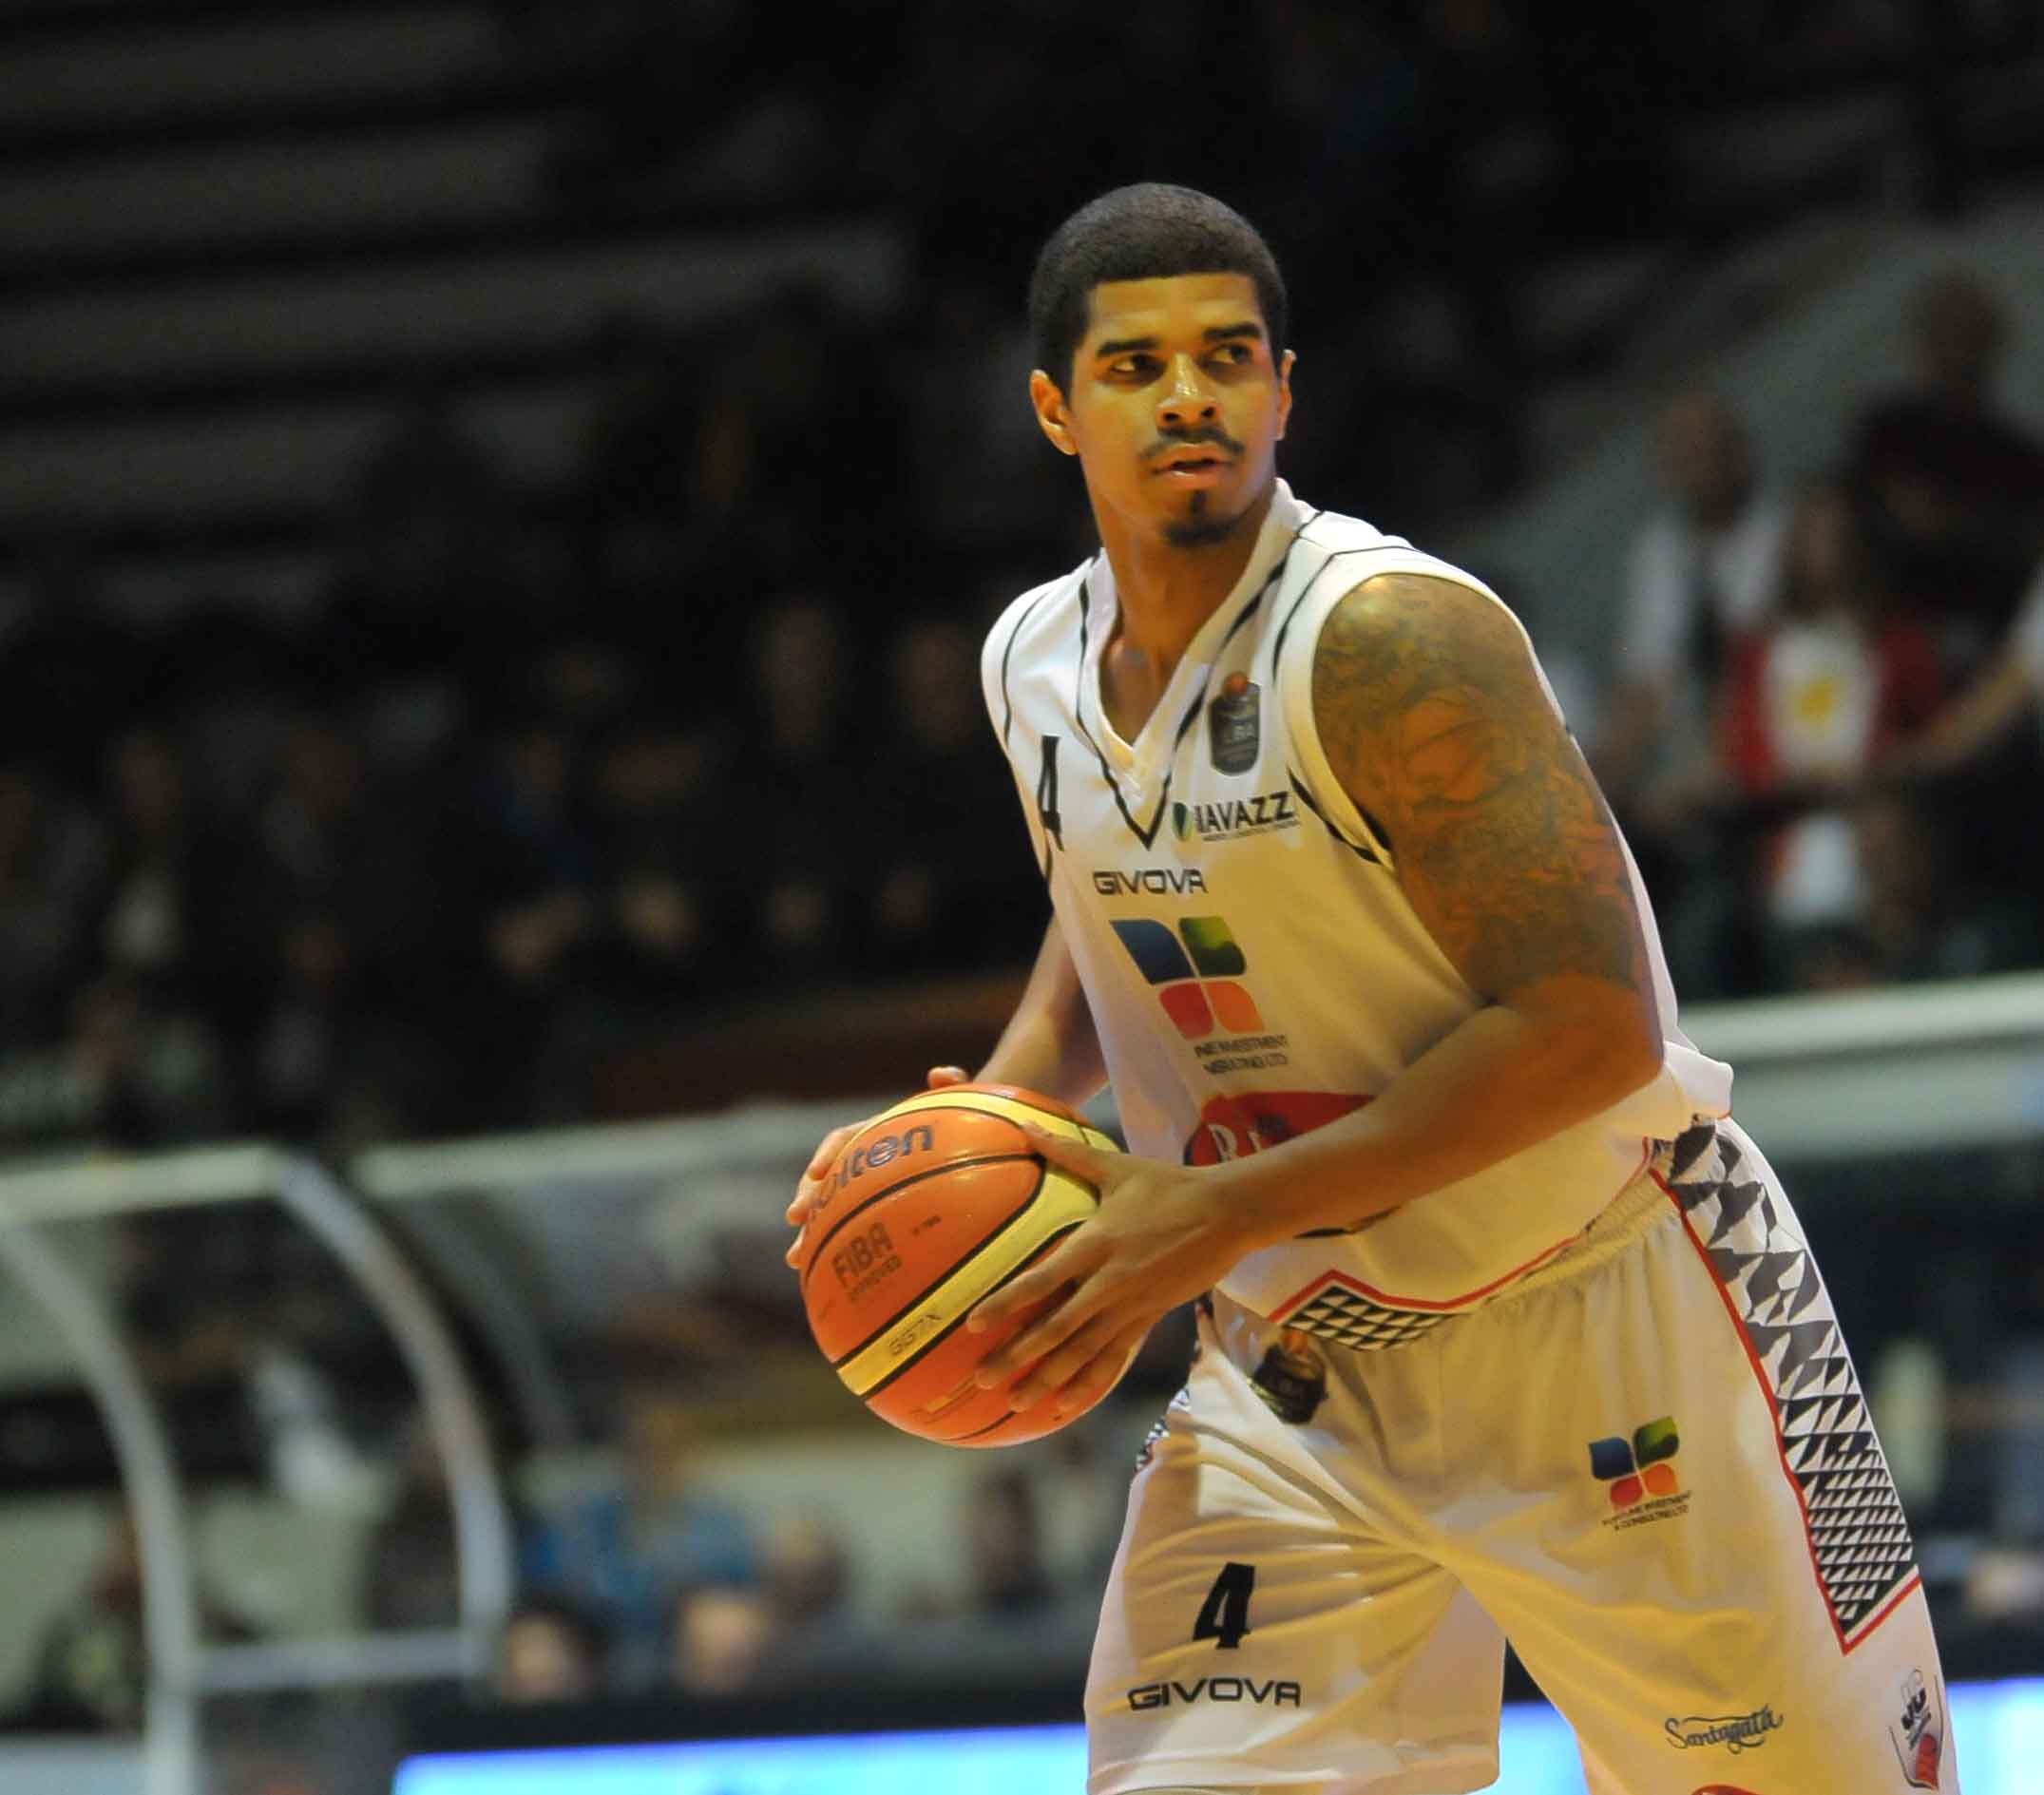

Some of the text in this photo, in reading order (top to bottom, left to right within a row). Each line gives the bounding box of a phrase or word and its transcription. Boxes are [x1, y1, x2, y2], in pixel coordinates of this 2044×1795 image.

[1038, 735, 1064, 851] 4
[1094, 869, 1208, 895] GIVOVA
[1192, 1561, 1256, 1650] 4
[1127, 1677, 1301, 1710] GIVOVA
